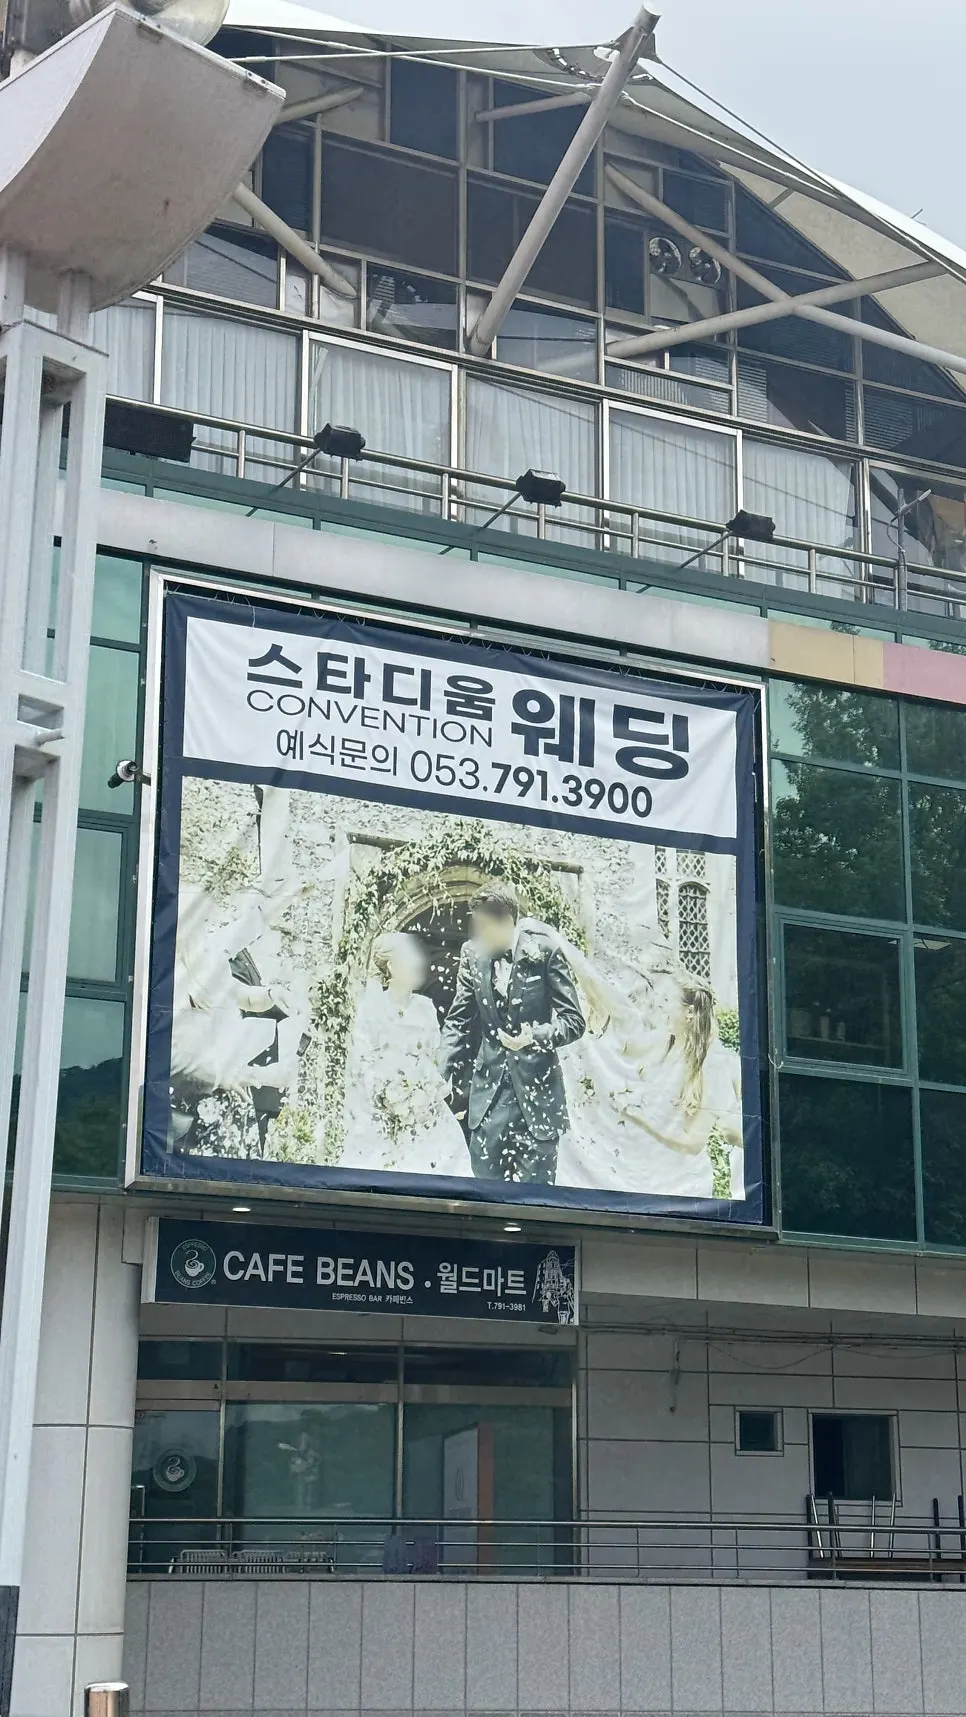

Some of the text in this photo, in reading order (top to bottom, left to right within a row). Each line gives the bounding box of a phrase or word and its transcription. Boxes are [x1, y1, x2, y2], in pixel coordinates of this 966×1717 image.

[246, 689, 493, 748] CONVENTION
[247, 643, 690, 780] 스타디움 웨딩
[276, 729, 653, 818] 예식문의 053.791.3900
[223, 1250, 527, 1297] CAFE BEANS 월드마트
[332, 1292, 367, 1302] ESPRESSO
[368, 1294, 383, 1303] BAR
[487, 1301, 526, 1312] T.791-3981
